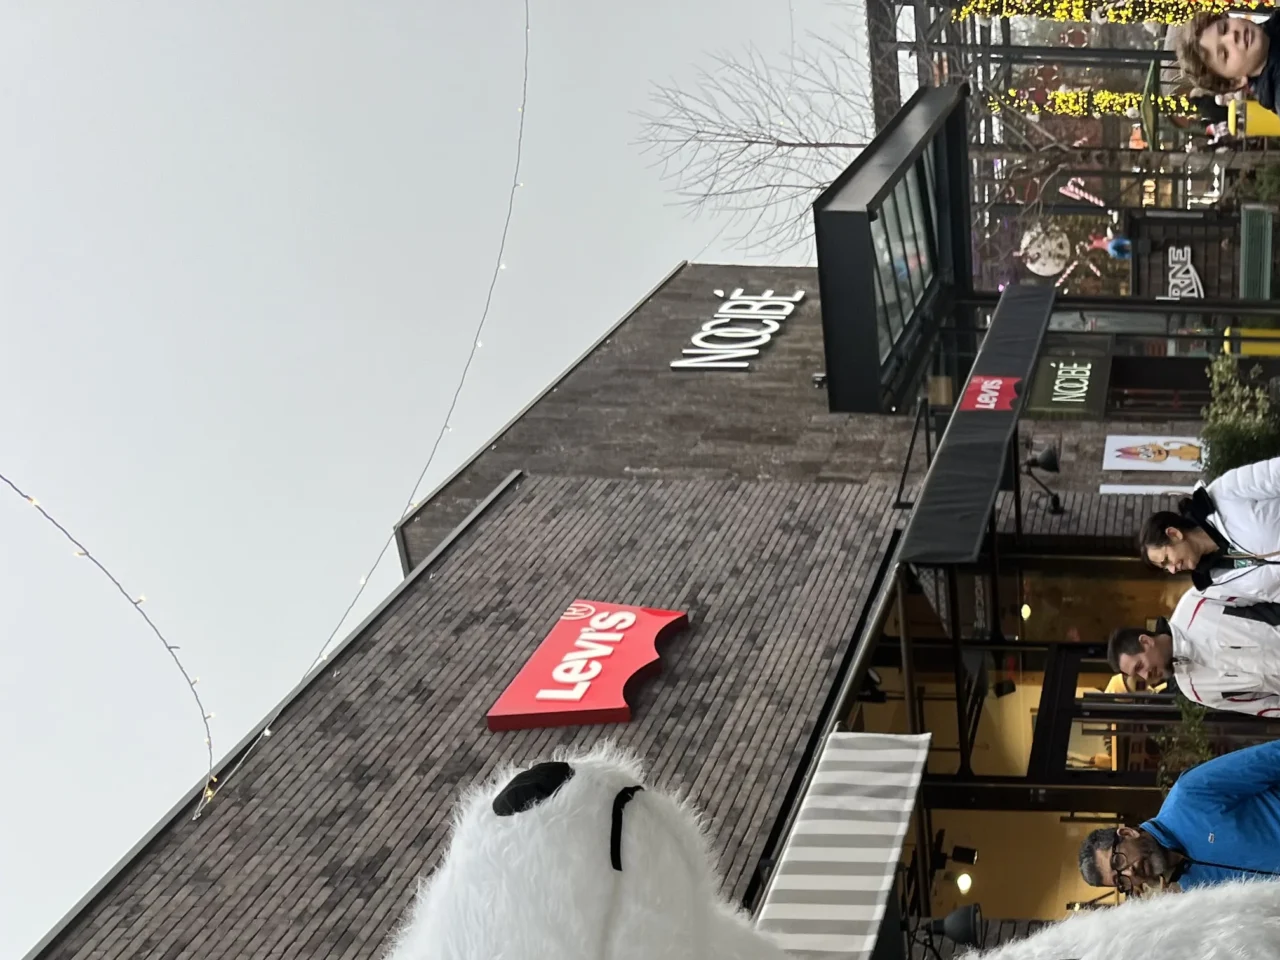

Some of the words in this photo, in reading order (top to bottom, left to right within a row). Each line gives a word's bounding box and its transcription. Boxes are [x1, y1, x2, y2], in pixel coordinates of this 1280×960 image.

[1168, 245, 1198, 300] RNE
[669, 288, 805, 367] NOCIBÉ
[1050, 362, 1092, 402] NOCIBÉ
